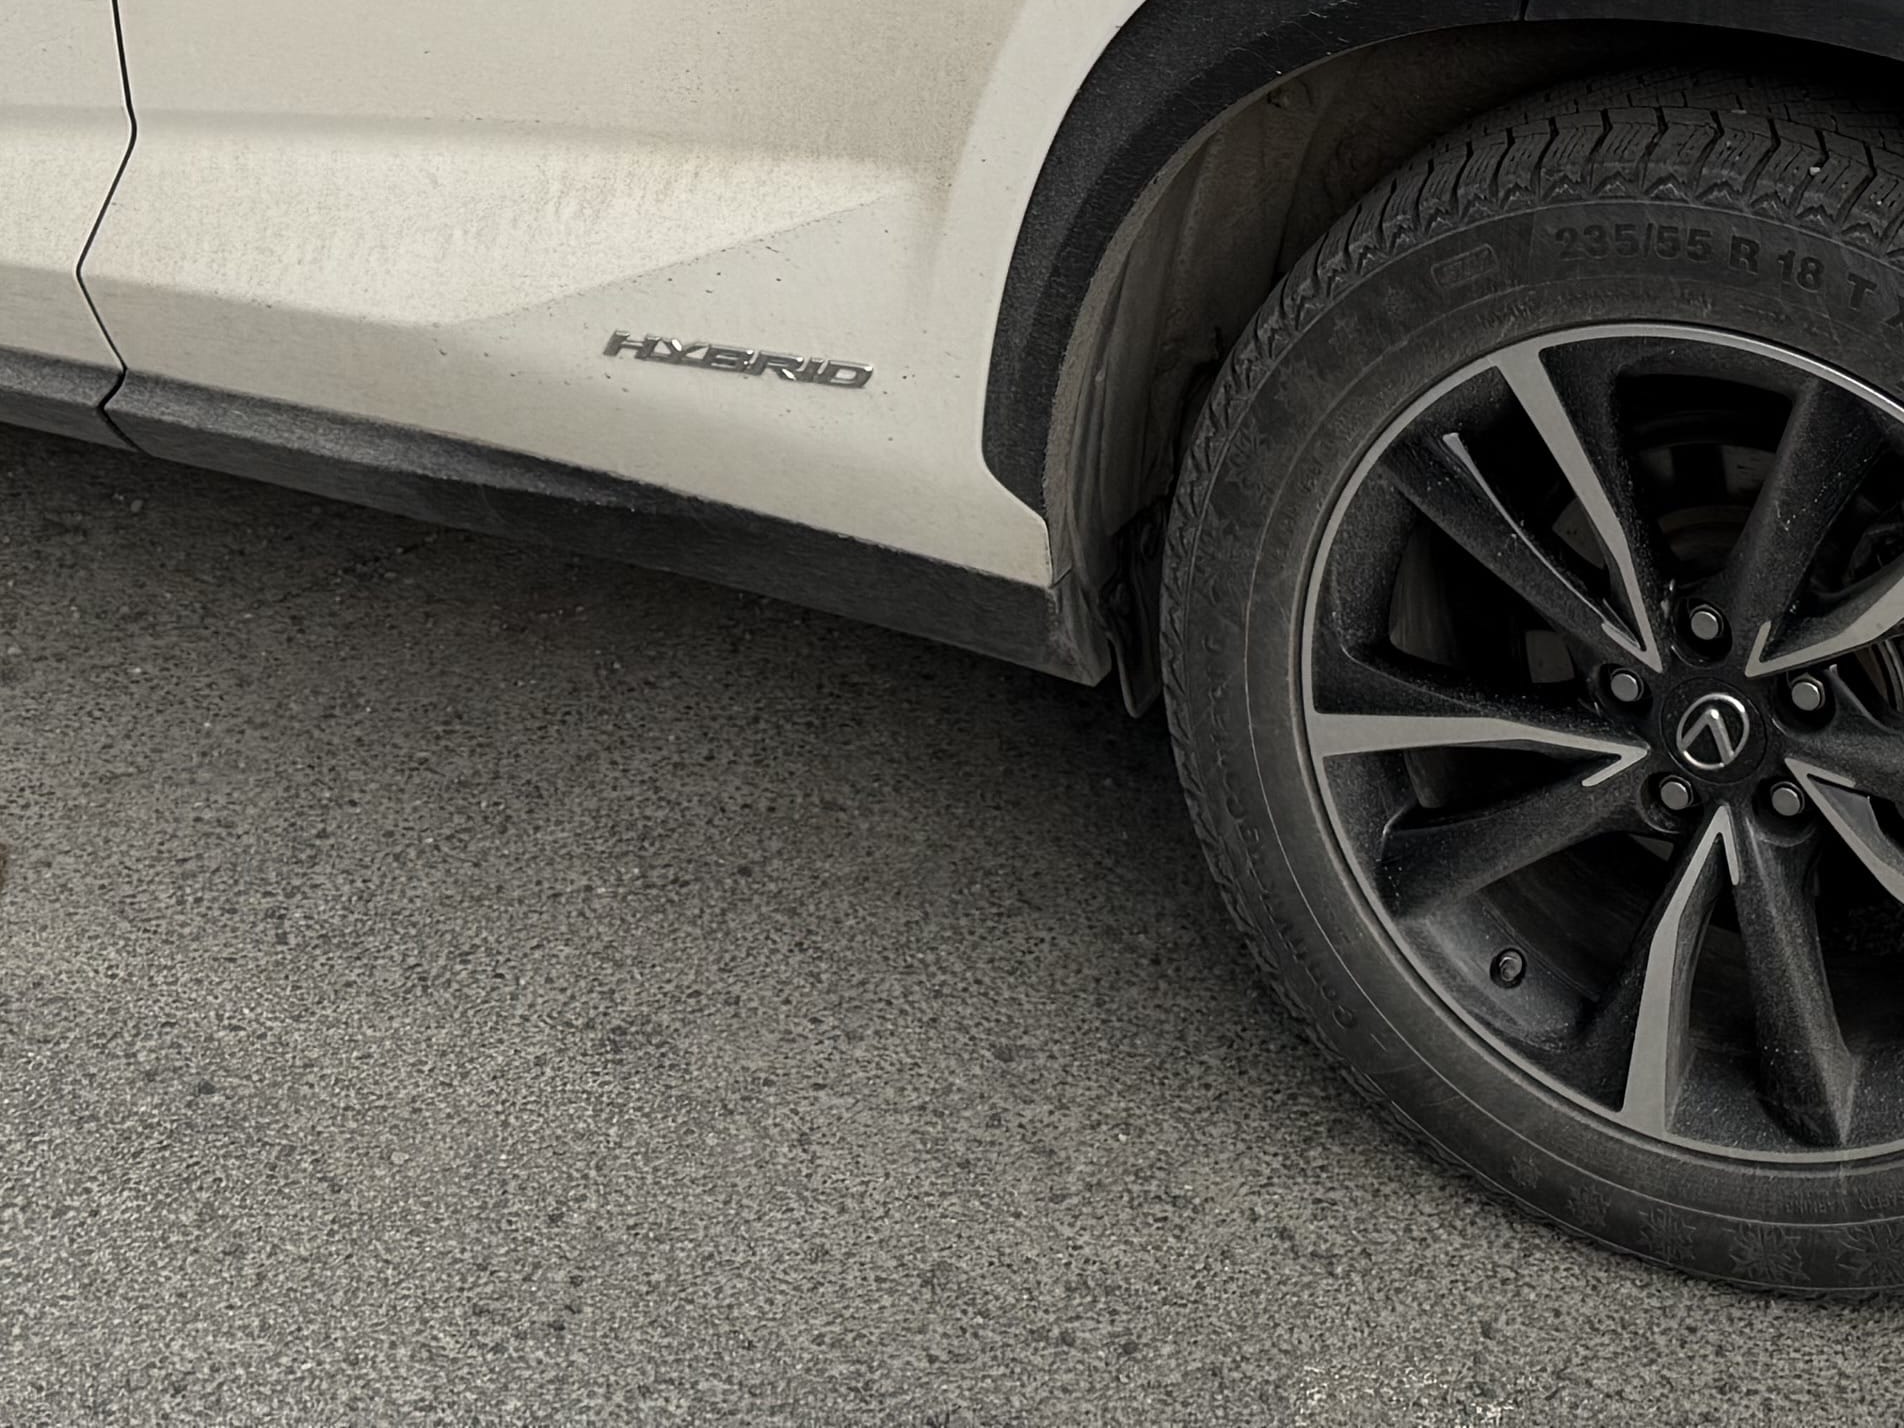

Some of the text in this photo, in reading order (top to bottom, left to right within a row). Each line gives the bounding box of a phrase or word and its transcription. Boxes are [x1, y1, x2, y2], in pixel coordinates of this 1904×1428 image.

[1553, 221, 1715, 263] 235/55
[1727, 234, 1761, 275] R
[1776, 249, 1826, 294] 18
[1845, 271, 1879, 312] T
[602, 329, 874, 388] HYBRID
